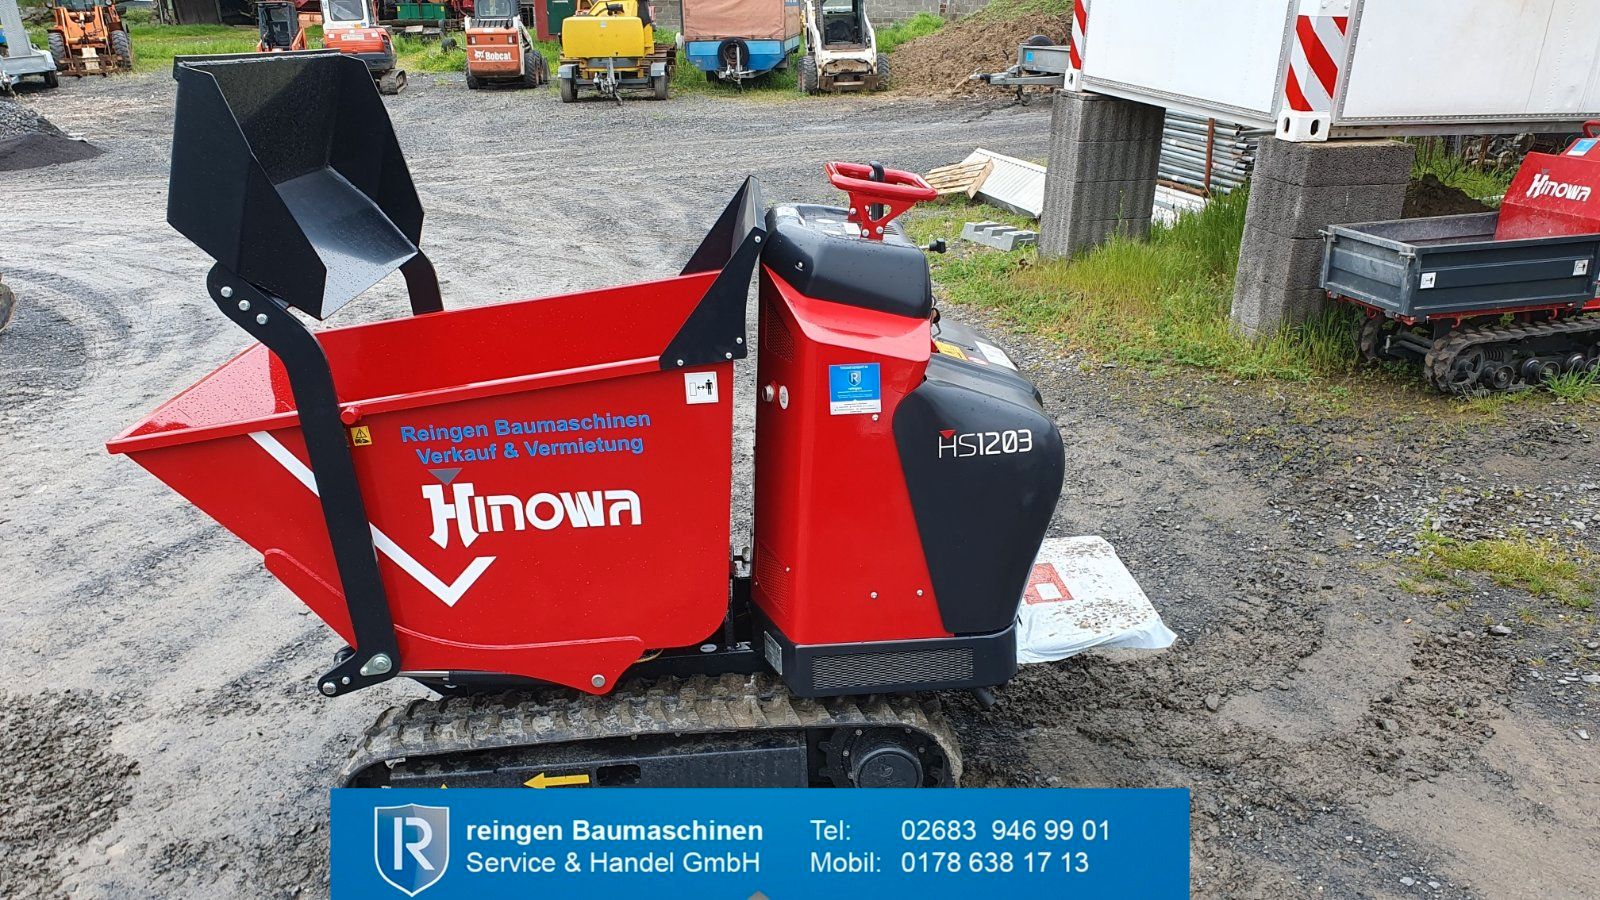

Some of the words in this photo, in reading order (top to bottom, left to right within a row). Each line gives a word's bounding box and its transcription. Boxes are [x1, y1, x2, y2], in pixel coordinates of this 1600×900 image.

[485, 51, 512, 60] Bobcat
[401, 424, 488, 443] Reingen
[495, 412, 651, 436] Baumaschinen
[416, 444, 496, 465] Verkauf
[503, 443, 520, 459] &
[524, 436, 644, 459] Vermietung
[938, 429, 1033, 459] HS1203
